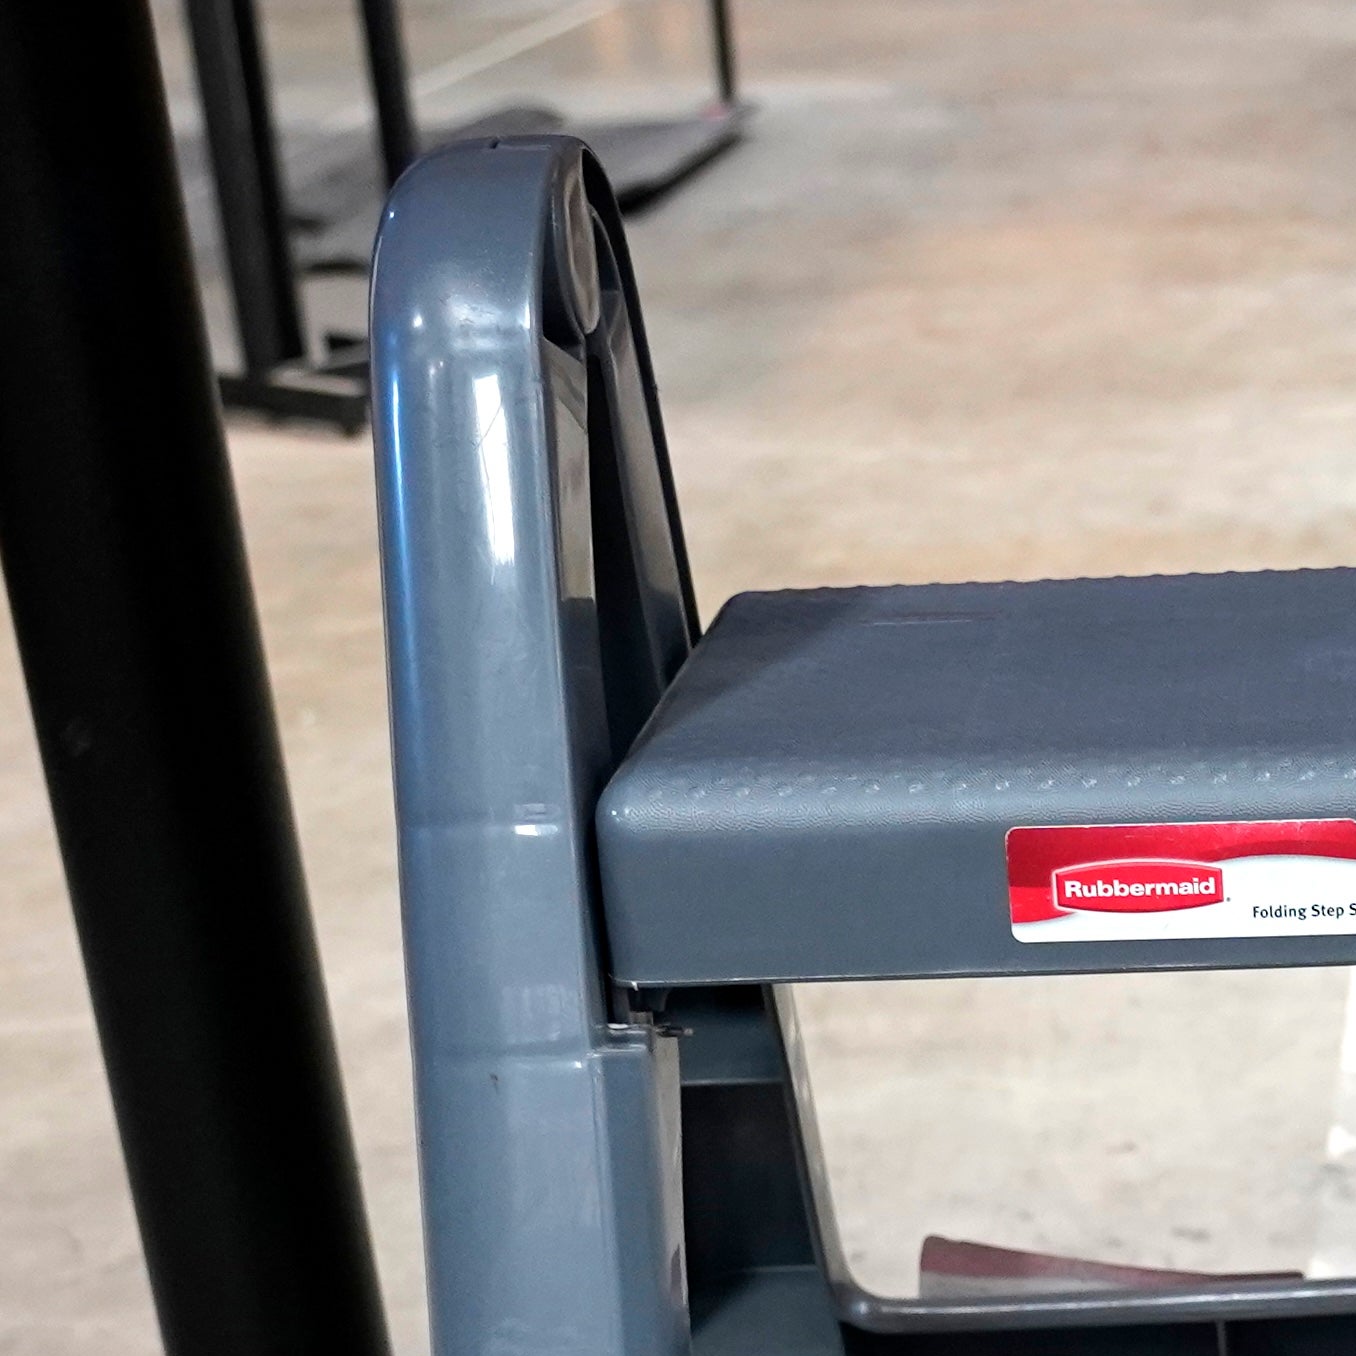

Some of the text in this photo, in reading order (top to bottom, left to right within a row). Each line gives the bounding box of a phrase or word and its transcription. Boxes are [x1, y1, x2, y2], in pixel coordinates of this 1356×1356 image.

[1063, 877, 1216, 898] Rubbermaid
[1252, 904, 1307, 920] Folding
[1311, 903, 1345, 919] Step
